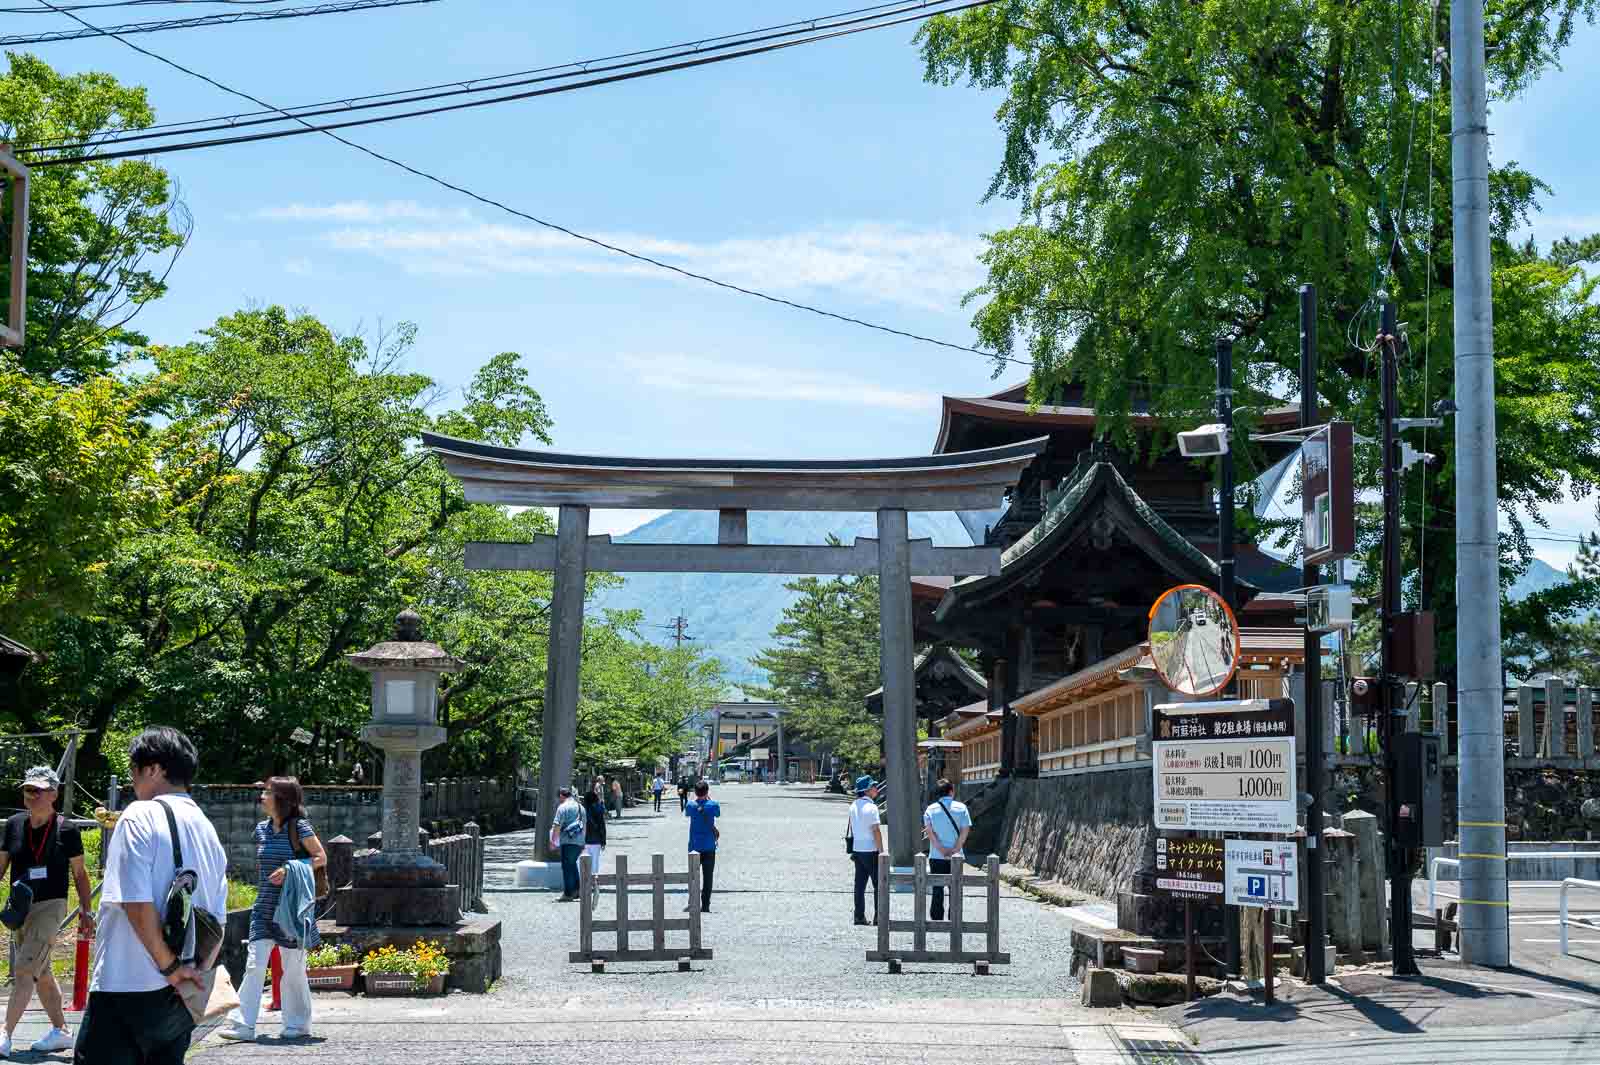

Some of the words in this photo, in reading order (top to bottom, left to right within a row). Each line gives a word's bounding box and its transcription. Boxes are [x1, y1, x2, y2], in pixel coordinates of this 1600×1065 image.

[1214, 720, 1251, 736] 第2駐車場
[1165, 775, 1187, 786] 最大料金
[1239, 777, 1282, 798] 1,000円
[1169, 841, 1223, 855] キャンピングカー
[1168, 857, 1224, 871] マイクロバス
[1252, 879, 1261, 895] P
